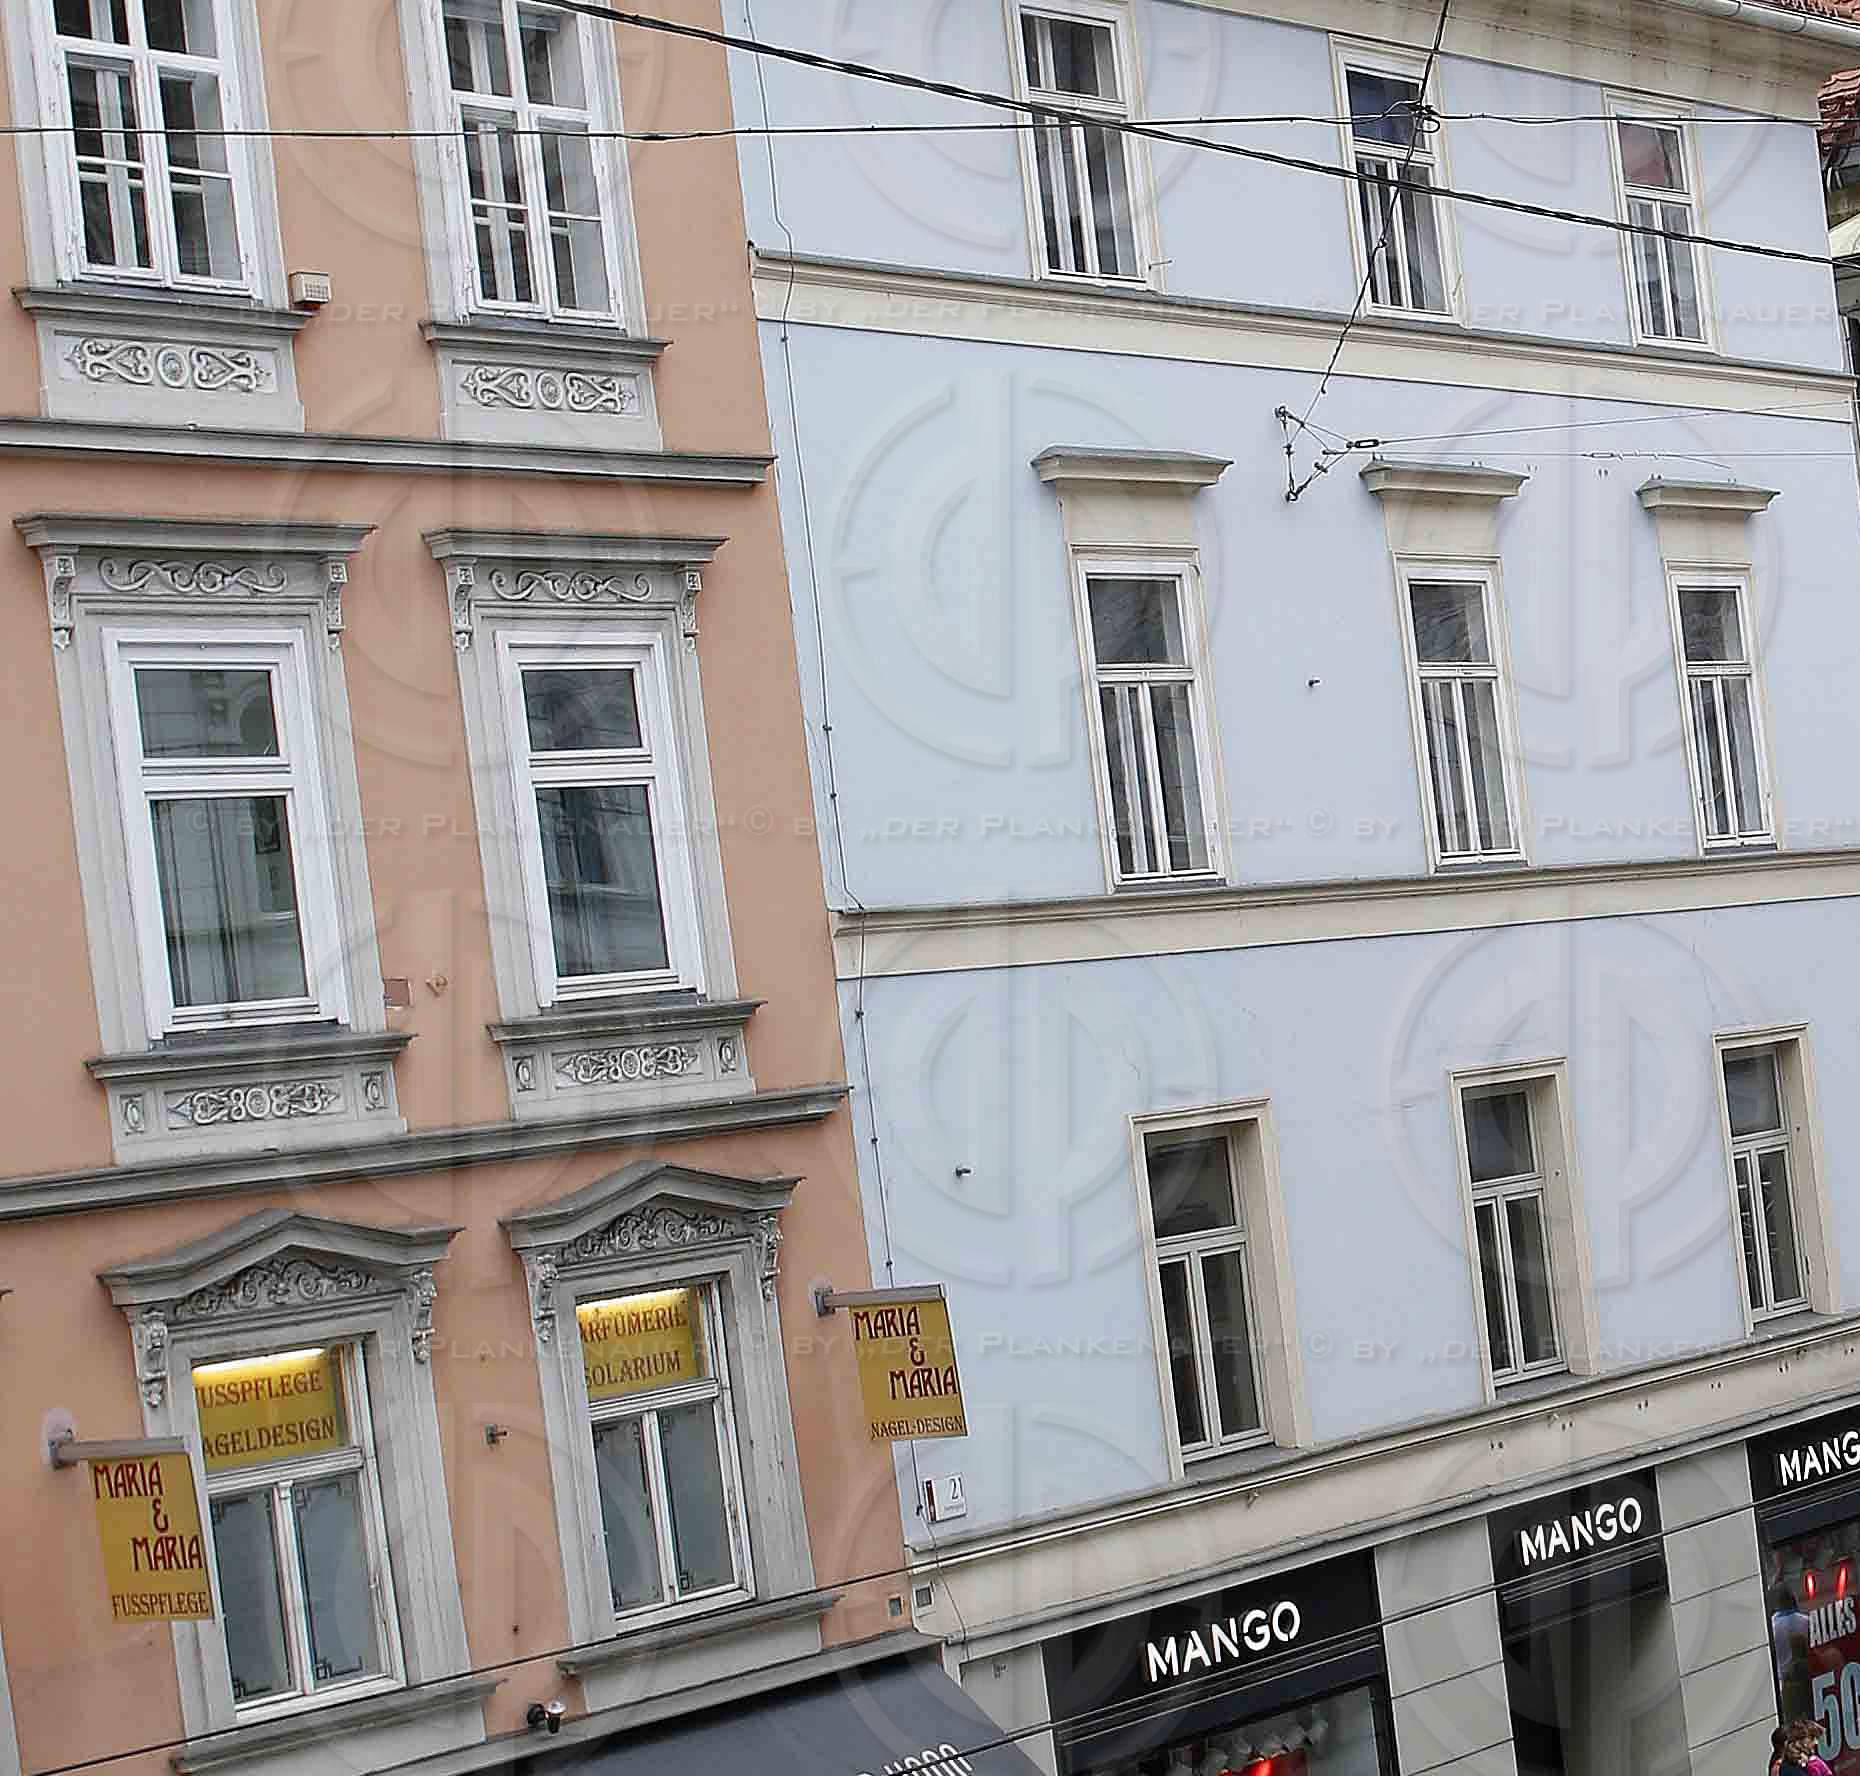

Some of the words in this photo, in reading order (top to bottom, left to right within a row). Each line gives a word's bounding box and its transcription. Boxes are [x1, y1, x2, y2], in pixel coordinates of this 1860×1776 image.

[854, 1306, 920, 1341] MARIA
[909, 1338, 926, 1366] &
[889, 1366, 958, 1401] MARIA
[871, 1415, 965, 1440] NAGEL-DESIGN
[94, 1461, 163, 1500] MARIA
[151, 1499, 169, 1534] &
[1519, 1496, 1643, 1568] MANGO
[132, 1535, 204, 1573] MARIA
[111, 1589, 209, 1618] FUSSPFLEGE
[1807, 1595, 1858, 1649] ALLES
[1145, 1599, 1302, 1684] MANGO
